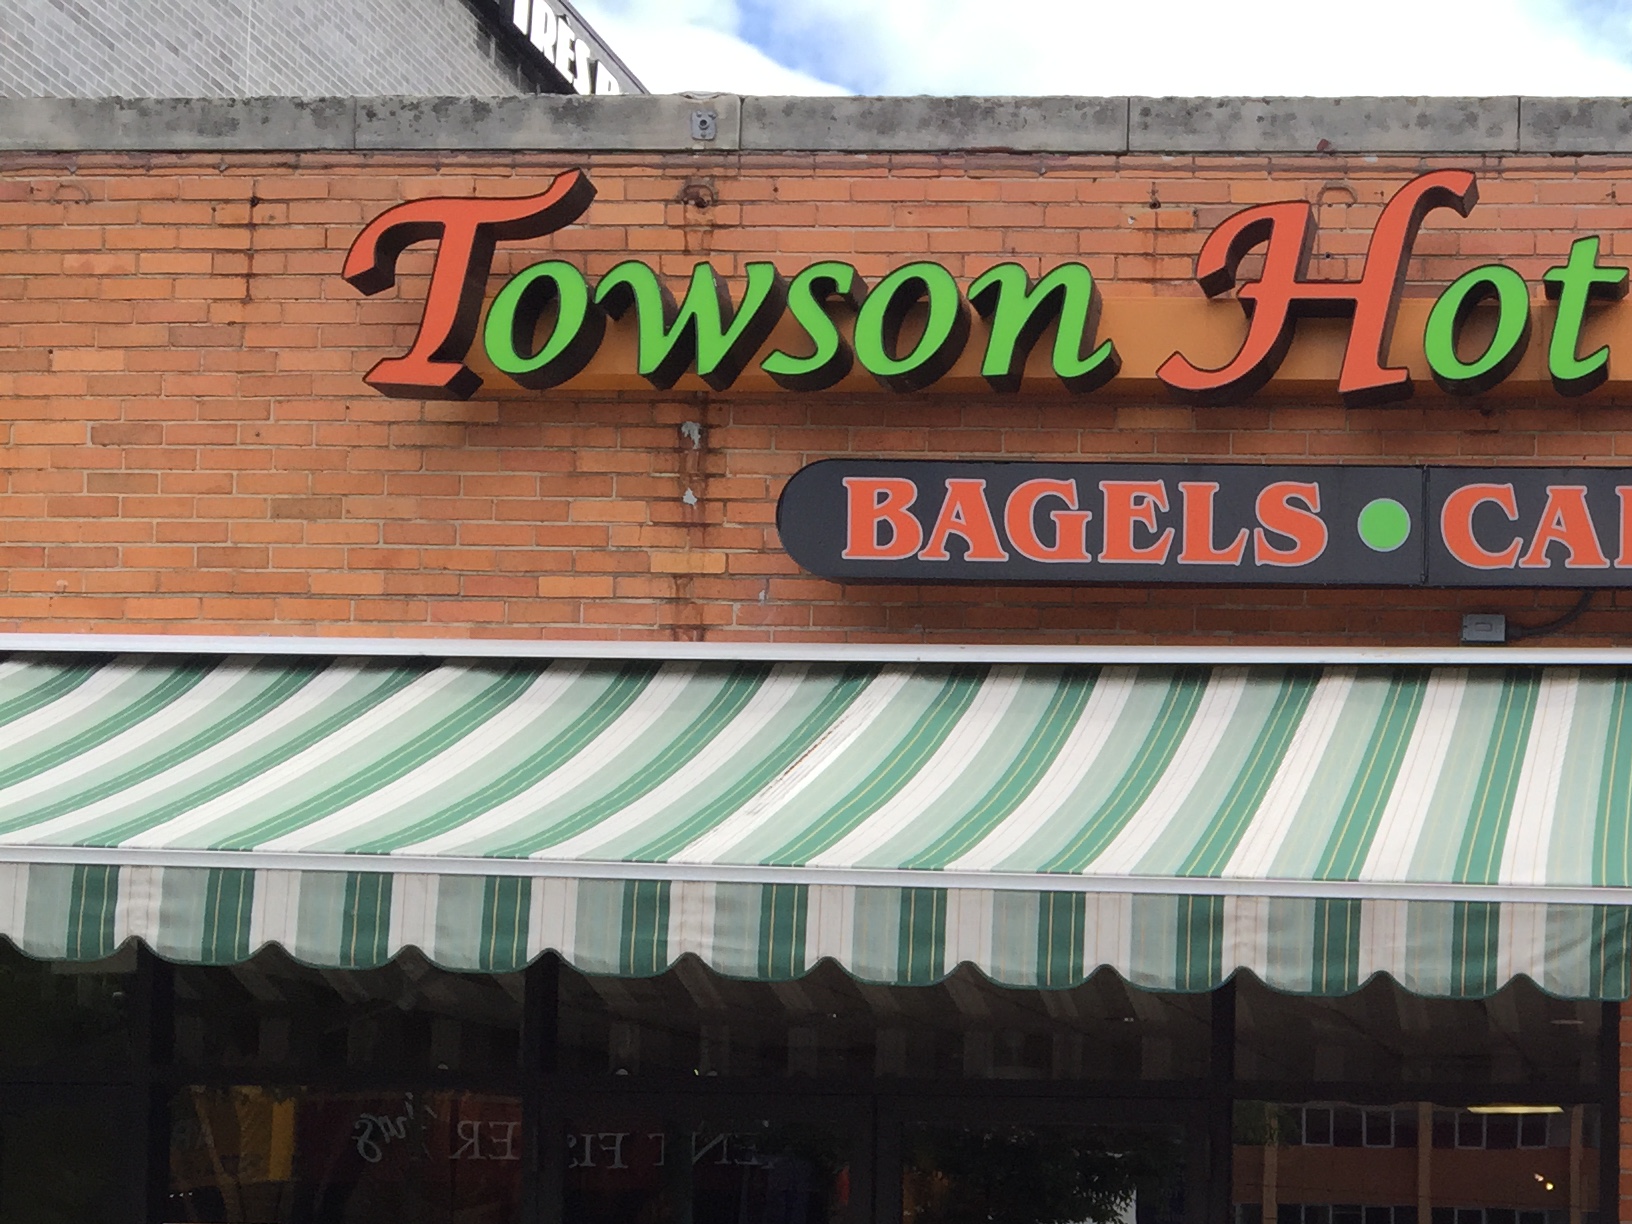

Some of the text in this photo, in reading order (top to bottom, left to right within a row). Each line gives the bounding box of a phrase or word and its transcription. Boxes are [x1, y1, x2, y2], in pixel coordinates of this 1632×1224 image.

[342, 168, 1120, 398] Towson
[1156, 169, 1629, 396] Hot
[841, 476, 1329, 567] BAGELS
